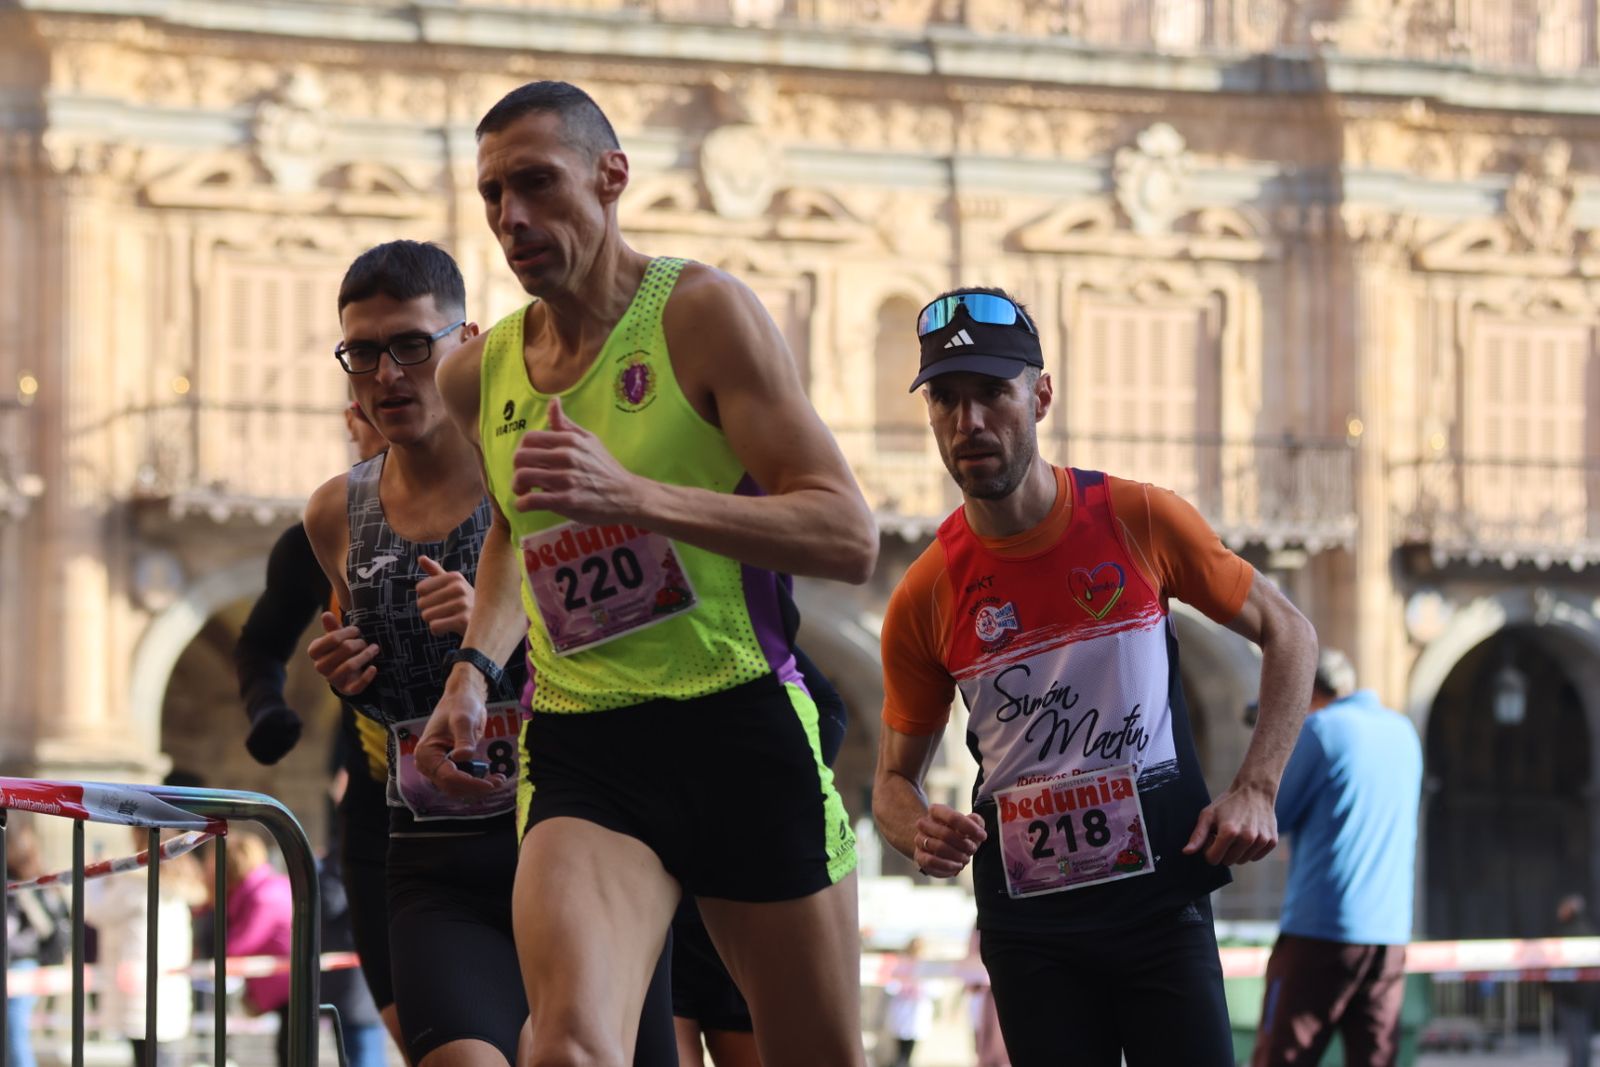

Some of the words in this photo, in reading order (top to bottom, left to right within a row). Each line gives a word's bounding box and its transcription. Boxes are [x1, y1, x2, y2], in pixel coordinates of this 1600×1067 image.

[555, 547, 644, 611] 220
[994, 664, 1080, 722] Simón
[1025, 704, 1149, 762] Martín
[9, 793, 61, 814] Ayuntamiento
[998, 776, 1134, 823] bedunia
[1028, 809, 1111, 860] 218
